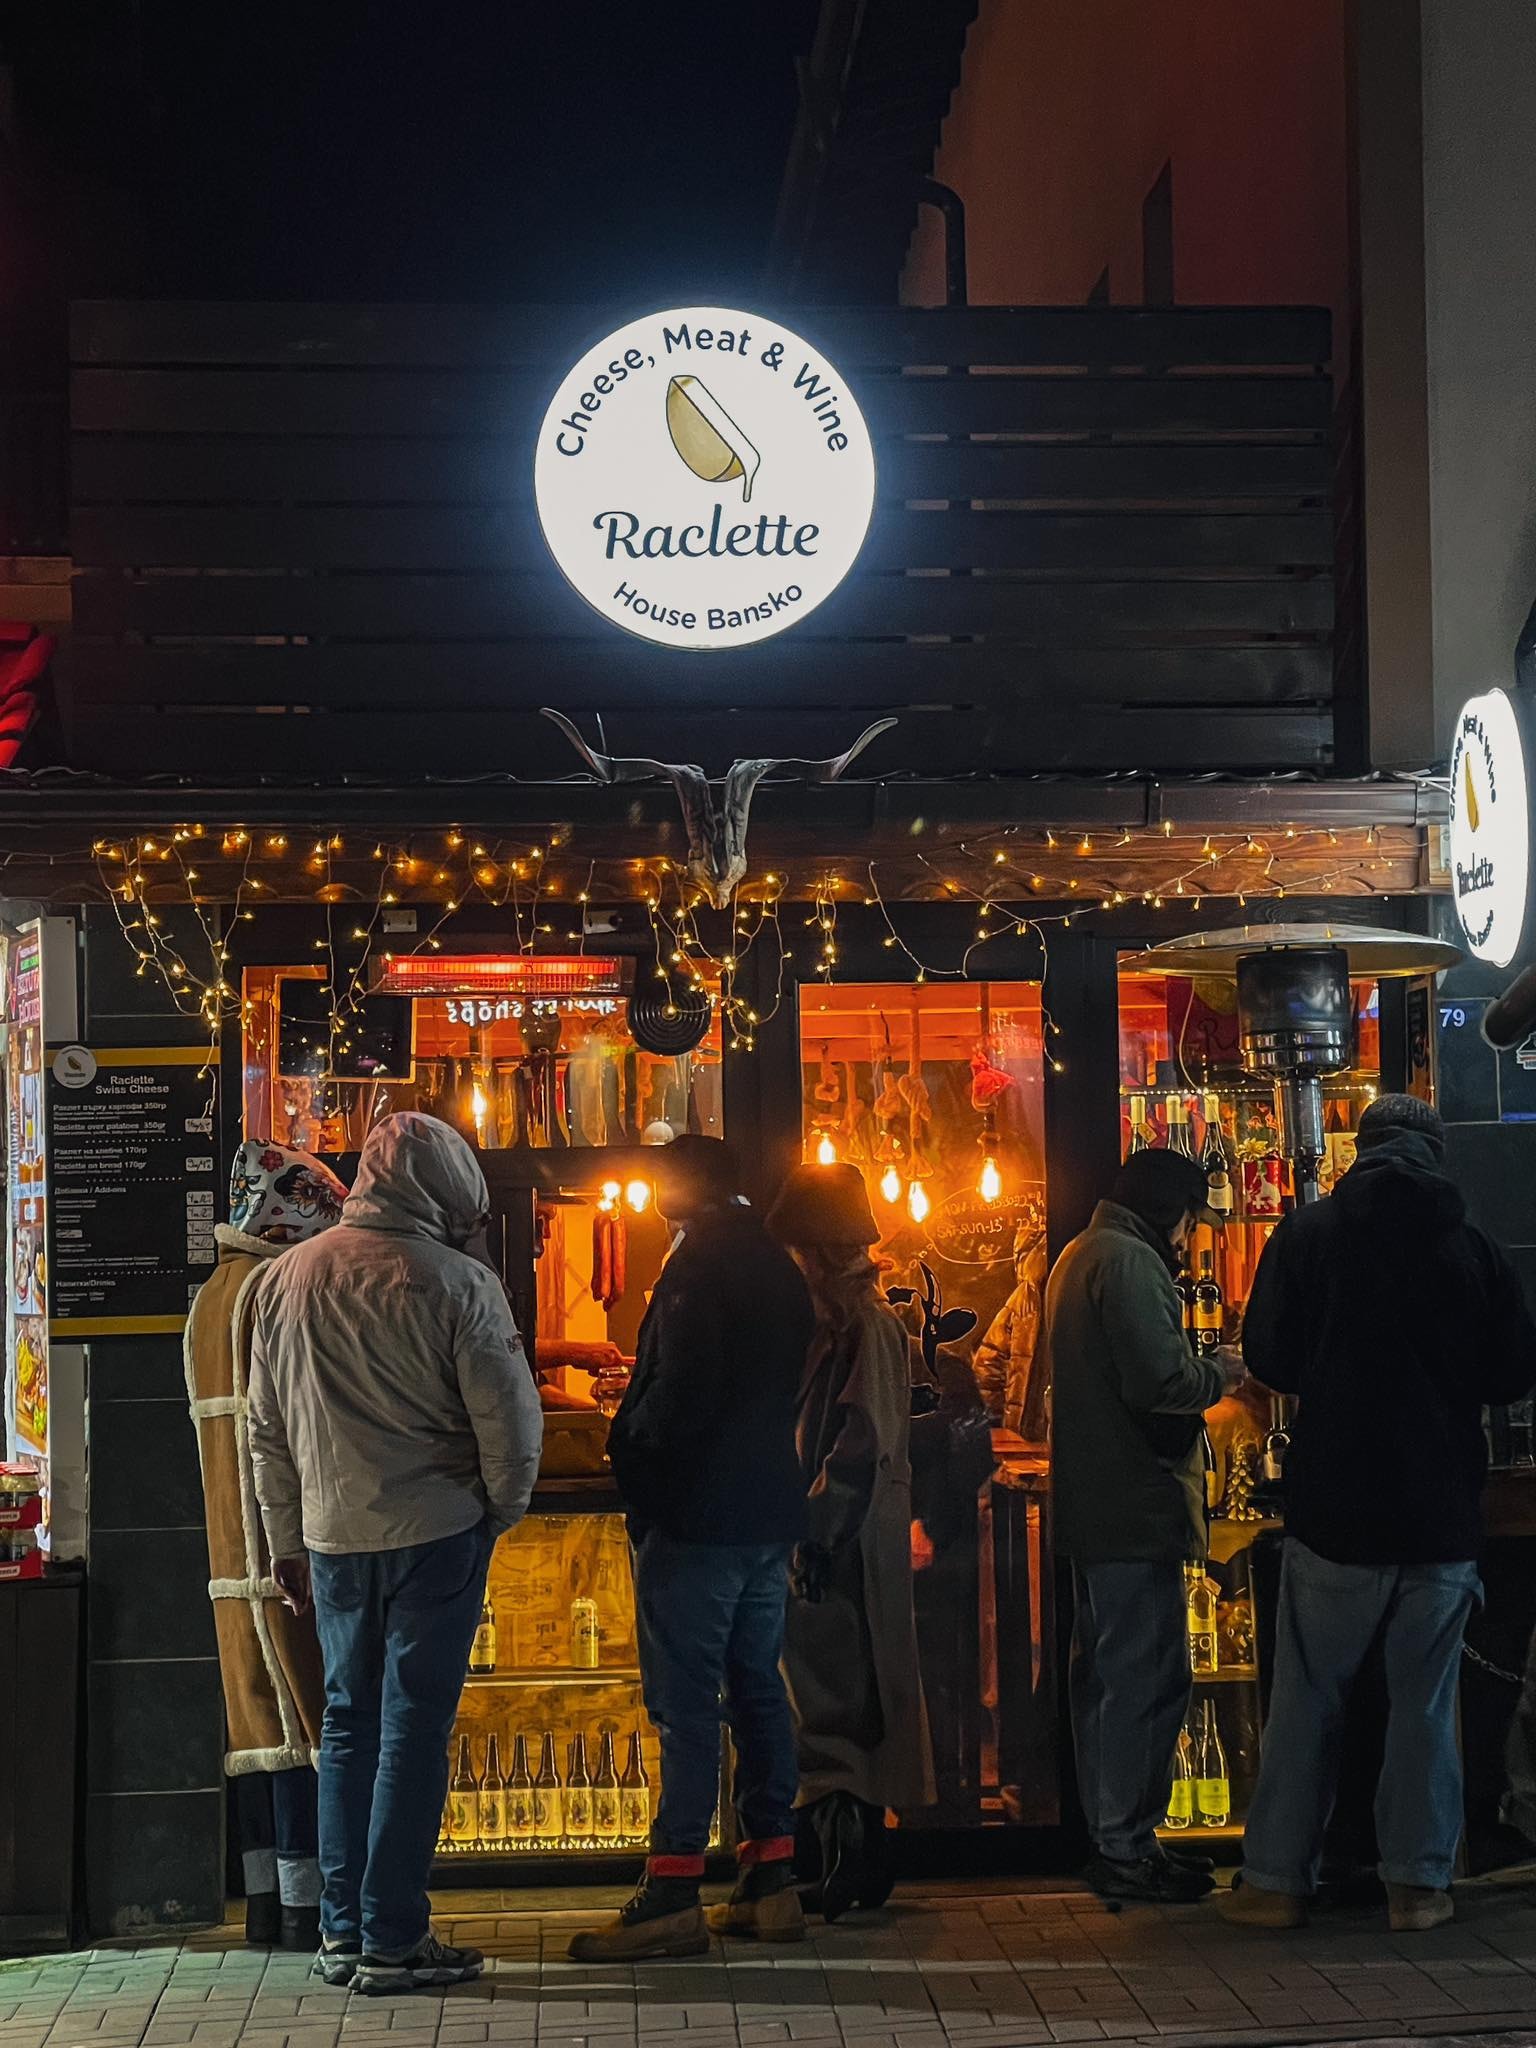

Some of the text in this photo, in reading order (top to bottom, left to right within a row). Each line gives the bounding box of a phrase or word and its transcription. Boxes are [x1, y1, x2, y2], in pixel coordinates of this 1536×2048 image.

[556, 324, 848, 456] Cheese, Meat & Wine
[593, 504, 819, 559] Raclette
[614, 582, 802, 629] House Bansko
[1439, 1008, 1465, 1027] 79
[96, 1085, 169, 1094] Swiss Cheese
[110, 1075, 154, 1085] Raclette
